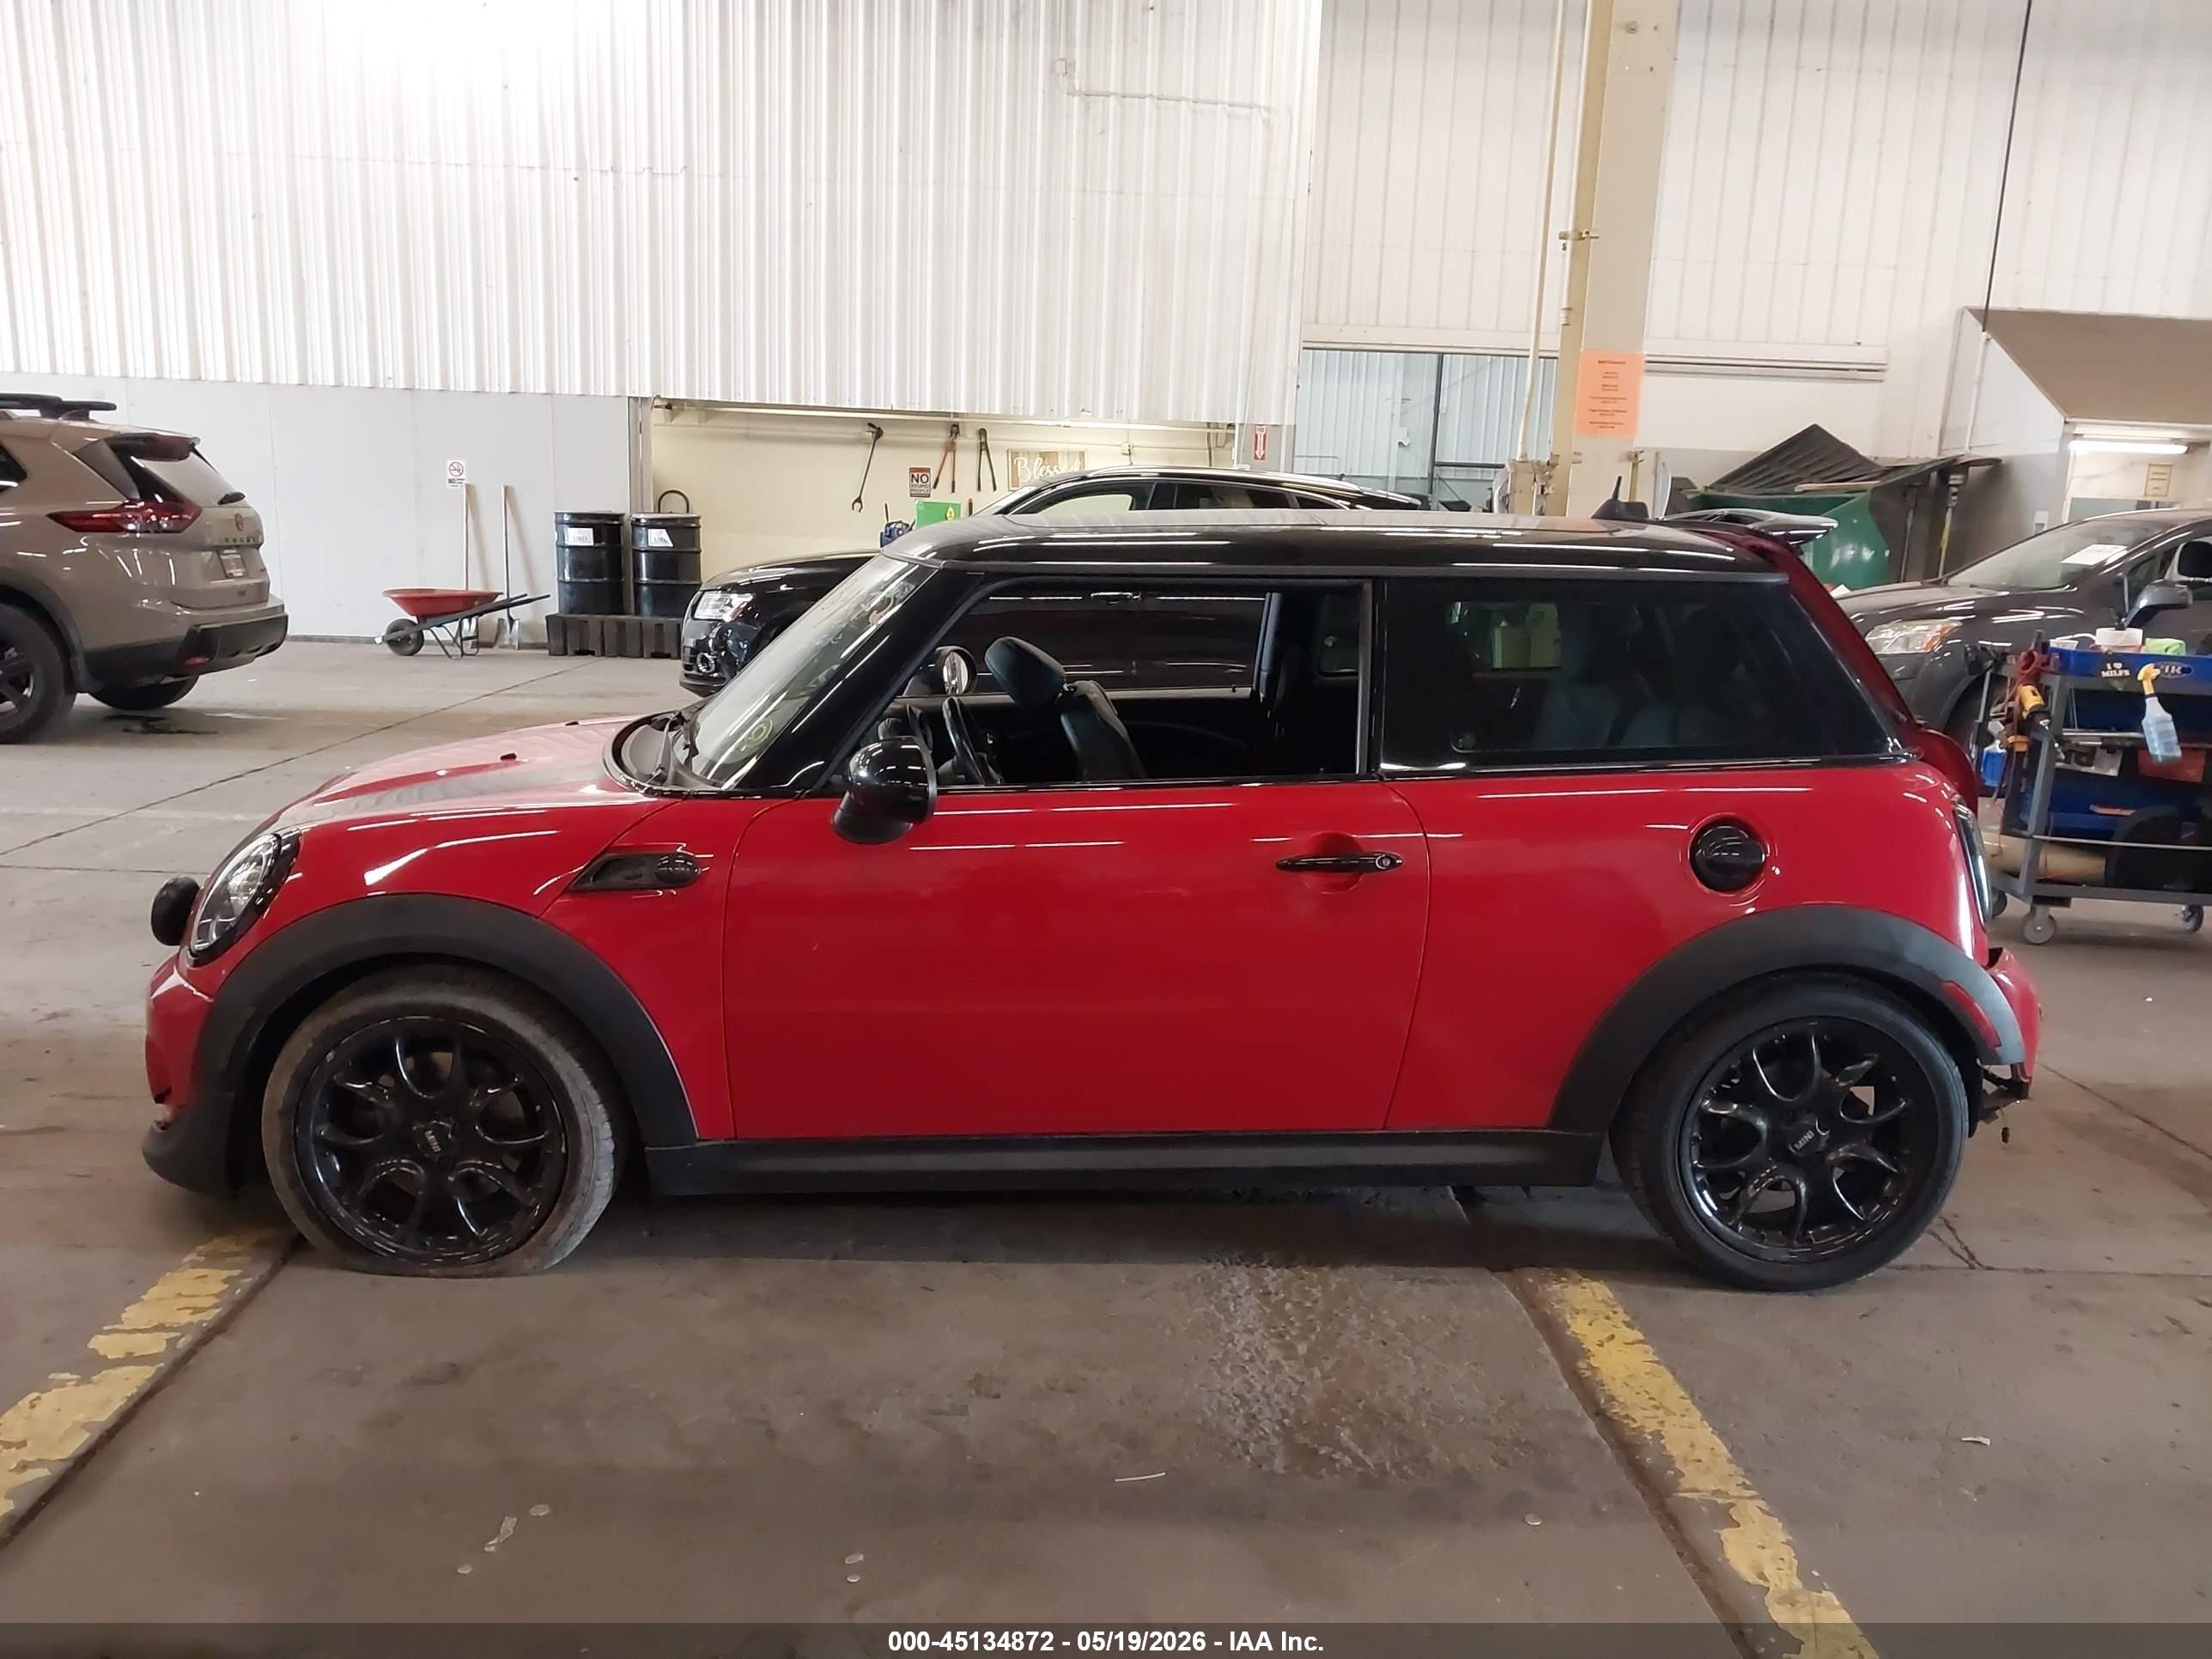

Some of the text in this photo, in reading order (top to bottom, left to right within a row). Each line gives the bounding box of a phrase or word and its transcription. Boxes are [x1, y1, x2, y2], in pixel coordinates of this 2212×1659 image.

[911, 473, 929, 483] NO
[424, 1130, 441, 1152] MINI
[1794, 1130, 1814, 1151] MINI
